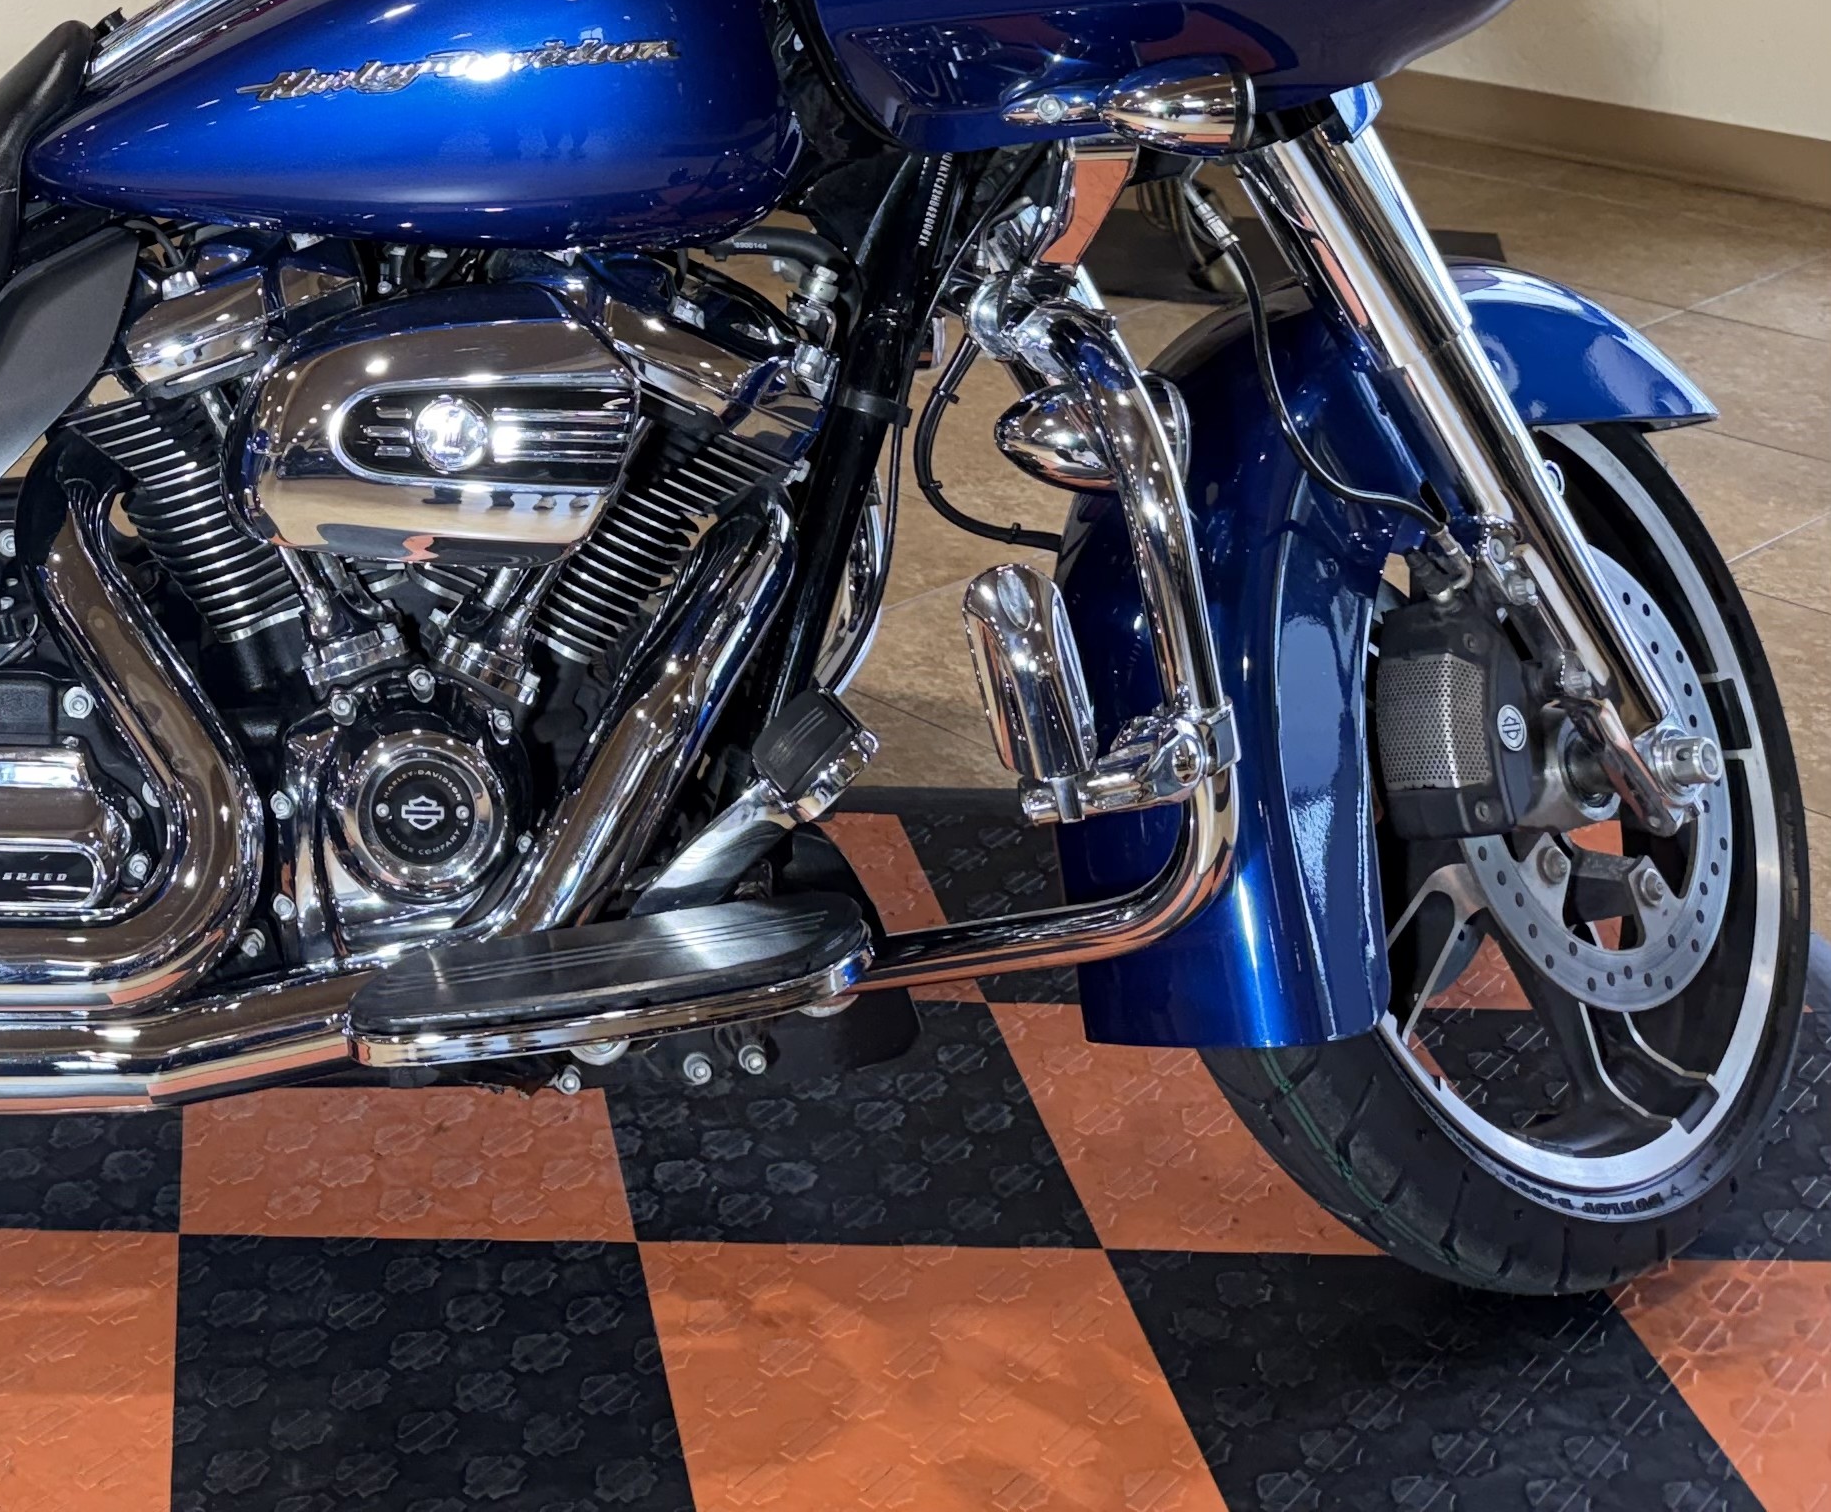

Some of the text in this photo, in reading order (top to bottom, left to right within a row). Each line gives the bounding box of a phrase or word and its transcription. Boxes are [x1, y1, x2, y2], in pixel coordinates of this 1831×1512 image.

[384, 769, 462, 801] HARLEY-DAVIDSON
[386, 827, 460, 855] MOTOR COMPANY
[2, 872, 67, 881] SPEED
[1582, 1192, 1665, 1215] DUNLOP
